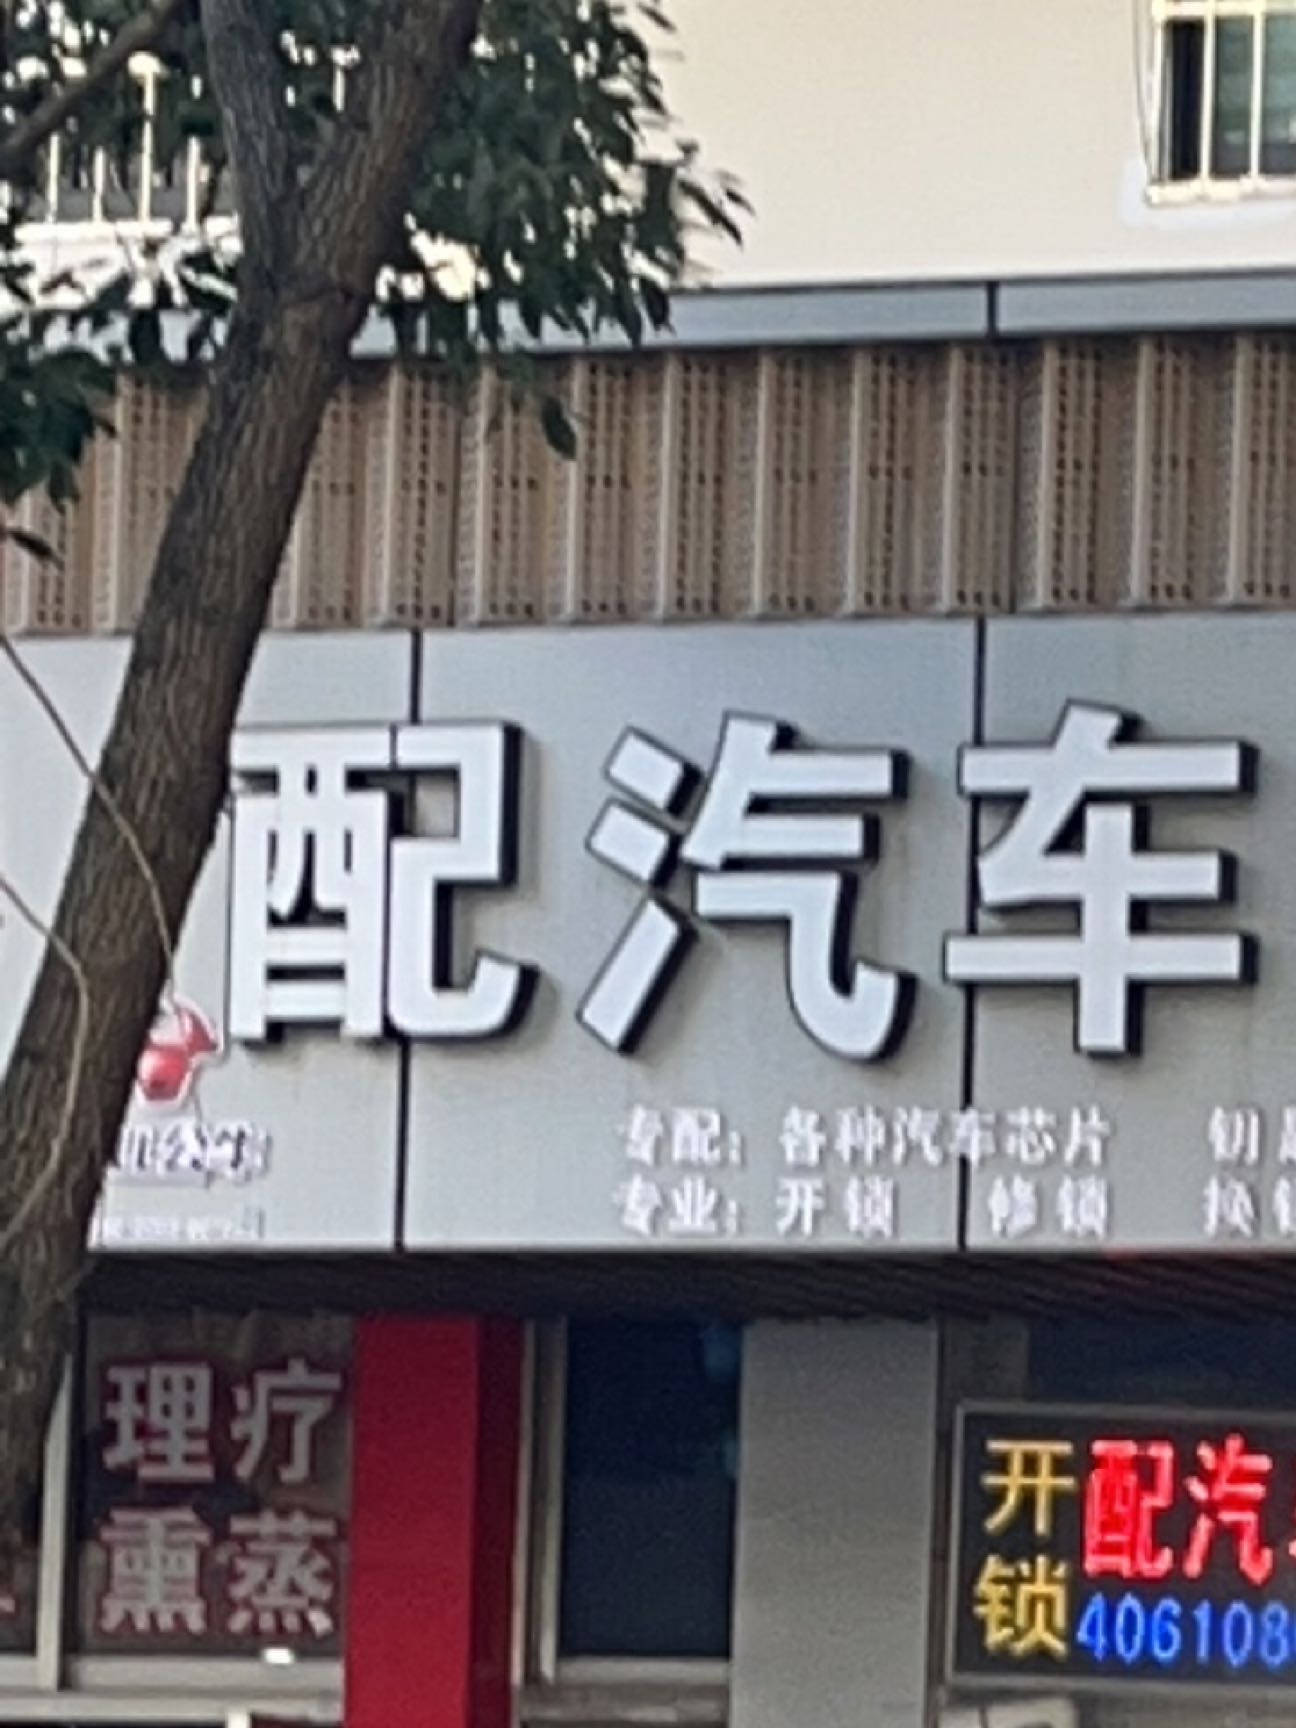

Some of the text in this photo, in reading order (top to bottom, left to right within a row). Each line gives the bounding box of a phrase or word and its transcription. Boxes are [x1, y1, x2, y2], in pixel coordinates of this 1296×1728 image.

[780, 1105, 1110, 1167] 各种汽车芯片
[776, 1176, 895, 1240] 开锁
[104, 1357, 342, 1486] 理疗
[100, 1506, 338, 1638] 熏蒸
[974, 1437, 1077, 1660] 开锁
